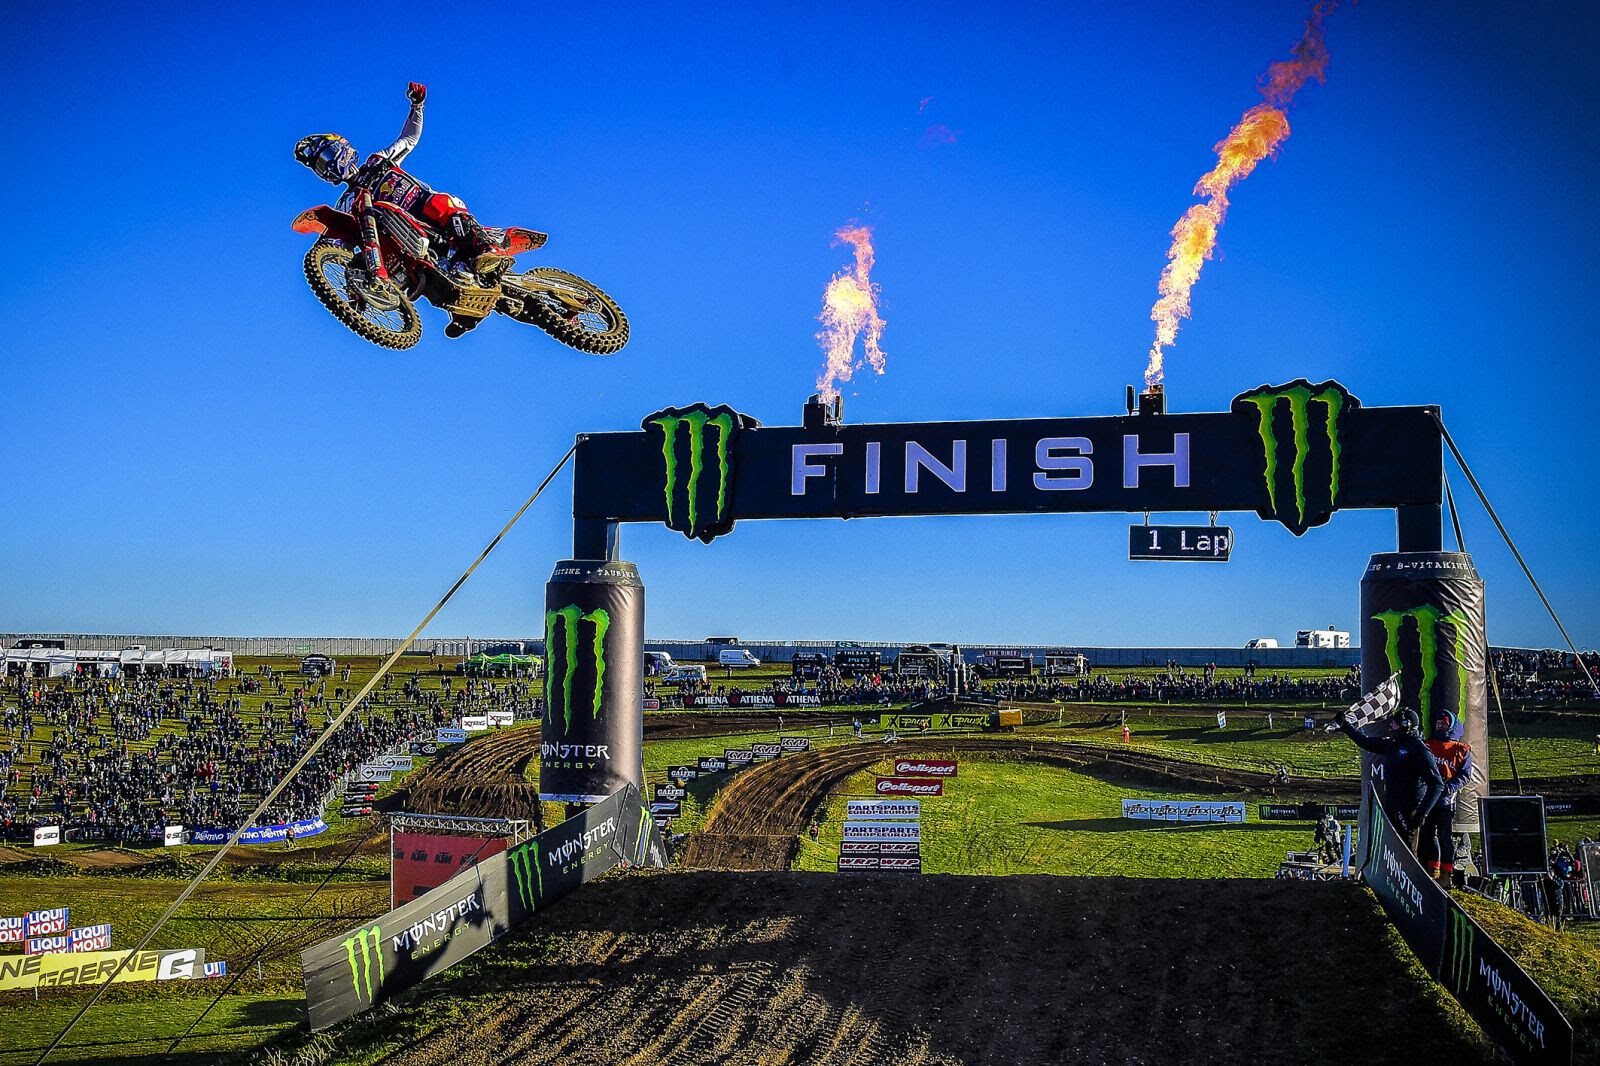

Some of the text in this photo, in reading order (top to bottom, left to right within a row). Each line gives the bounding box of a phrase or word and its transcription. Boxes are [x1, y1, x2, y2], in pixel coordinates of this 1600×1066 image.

[791, 432, 1191, 497] FINISH
[1148, 529, 1230, 557] 1 Lap
[694, 696, 729, 705] ATHENA
[740, 695, 775, 704] ATHENA
[785, 695, 821, 704] ATHENA
[489, 714, 512, 722] XTRIG
[464, 719, 486, 727] XTRIG
[700, 760, 726, 768] GALFER
[896, 762, 955, 773] Polisport
[670, 769, 696, 777] GALFER
[877, 781, 940, 792] Polisport
[657, 788, 685, 797] GALFER
[1124, 805, 1151, 814] VERTEX
[1151, 806, 1179, 815] VERTEX
[1180, 807, 1210, 815] VERTEX
[1211, 808, 1241, 816] VERTEX
[842, 843, 880, 851] WRP
[880, 843, 918, 852] WRP
[411, 849, 428, 862] KTM
[434, 851, 453, 865] KTM
[562, 840, 610, 875] ENERGY
[839, 857, 879, 866] WRP
[879, 858, 920, 867] WRP
[29, 908, 63, 924] LIQUI
[29, 919, 64, 936] MOLY
[71, 924, 106, 941] LIQUI
[30, 937, 66, 952] LIQUI
[73, 936, 108, 953] MOLY
[411, 921, 472, 960] ENERGY
[39, 952, 160, 986] GAERNE
